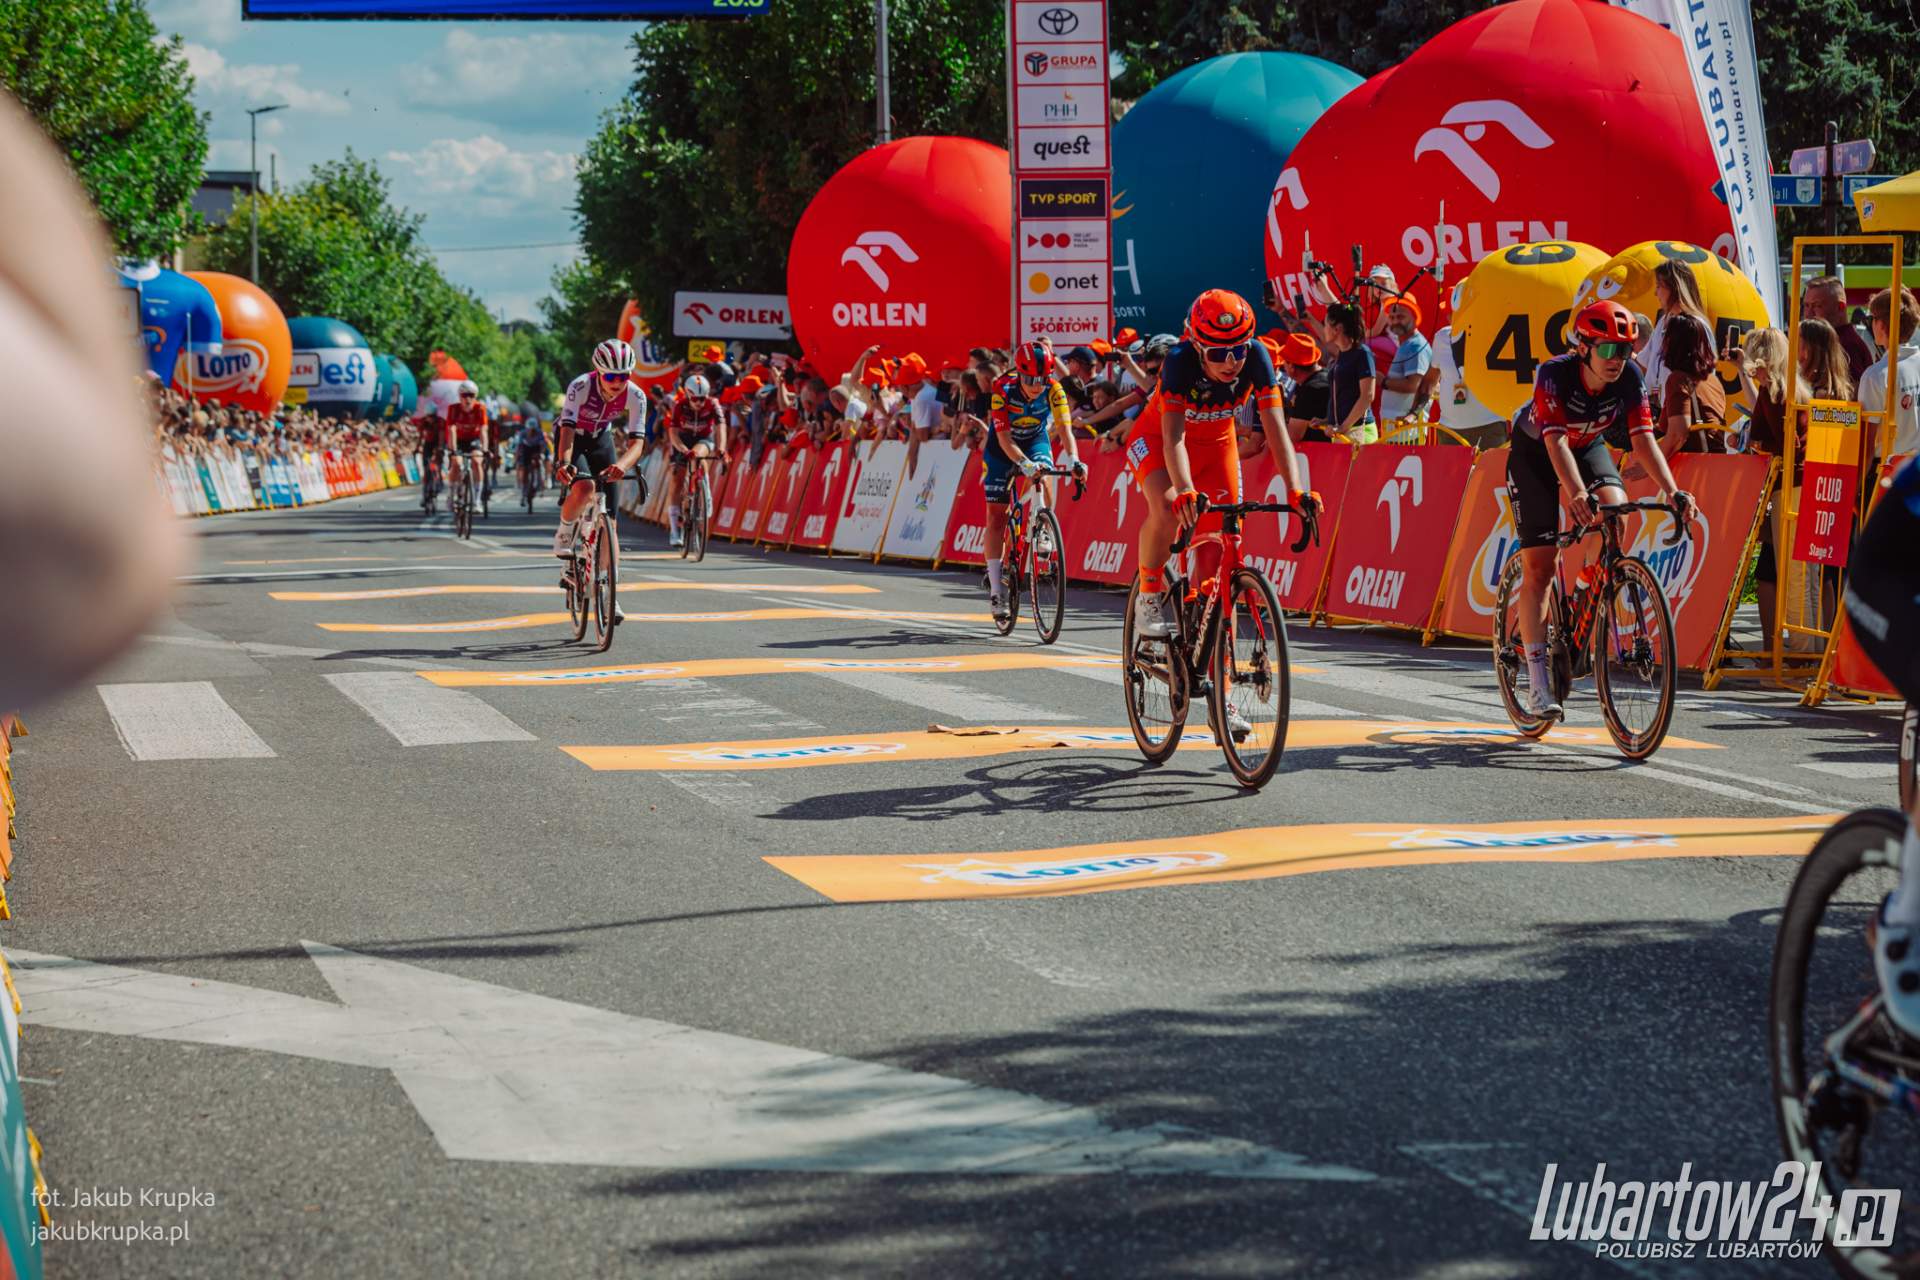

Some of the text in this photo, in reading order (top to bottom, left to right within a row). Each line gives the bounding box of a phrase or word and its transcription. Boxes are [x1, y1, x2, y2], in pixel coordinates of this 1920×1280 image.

[1050, 55, 1097, 66] GRUPA
[1718, 21, 1754, 201] www.lubartow.pl
[1033, 135, 1091, 160] quest
[1028, 192, 1098, 205] TVP SPORT
[1054, 274, 1099, 289] onet
[719, 308, 784, 325] ORLEN
[832, 302, 927, 327] ORLEN
[1030, 322, 1099, 333] SPORTOWY
[196, 352, 251, 379] LOTTO
[323, 352, 366, 385] est
[1815, 476, 1843, 503] CLUB
[1814, 510, 1836, 537] TDP
[954, 524, 986, 554] ORL
[1808, 543, 1833, 560] Stage 2
[1083, 540, 1127, 573] ORLEN
[1345, 565, 1406, 609] ORLEN
[980, 856, 1159, 880] LOTTO
